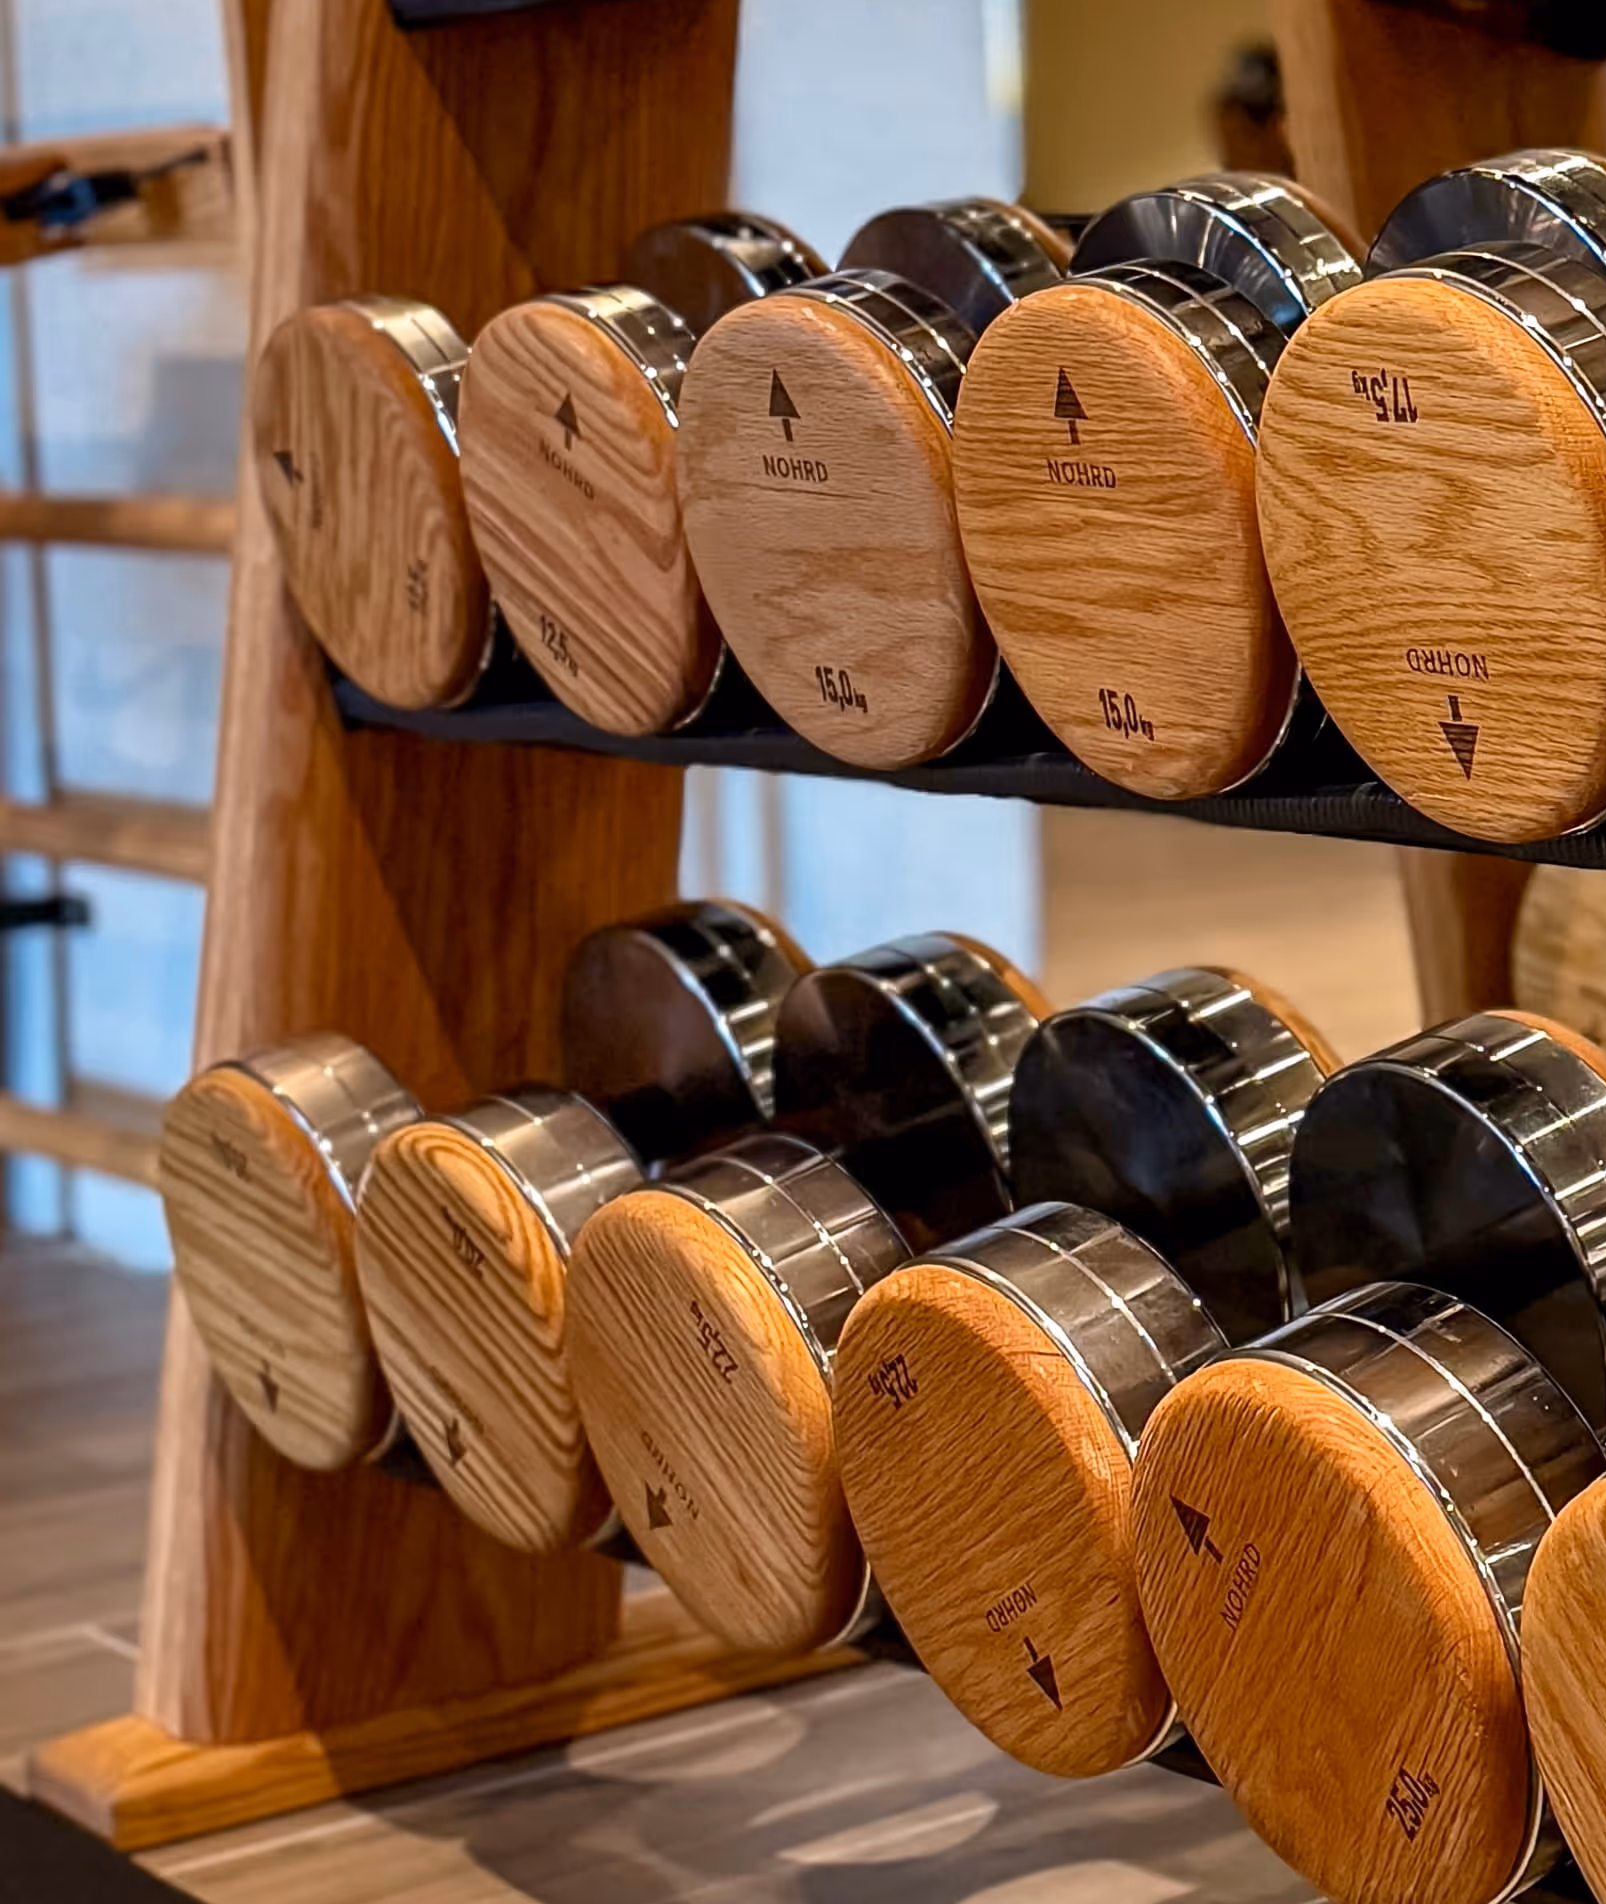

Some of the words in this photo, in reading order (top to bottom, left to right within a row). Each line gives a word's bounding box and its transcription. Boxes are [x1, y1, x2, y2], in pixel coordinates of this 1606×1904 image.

[762, 454, 828, 483] NOHRD
[1046, 459, 1117, 489] NOHRD
[1406, 646, 1491, 681] NOHRD
[1220, 1541, 1262, 1631] NOHRD
[985, 1583, 1038, 1634] NOHRD
